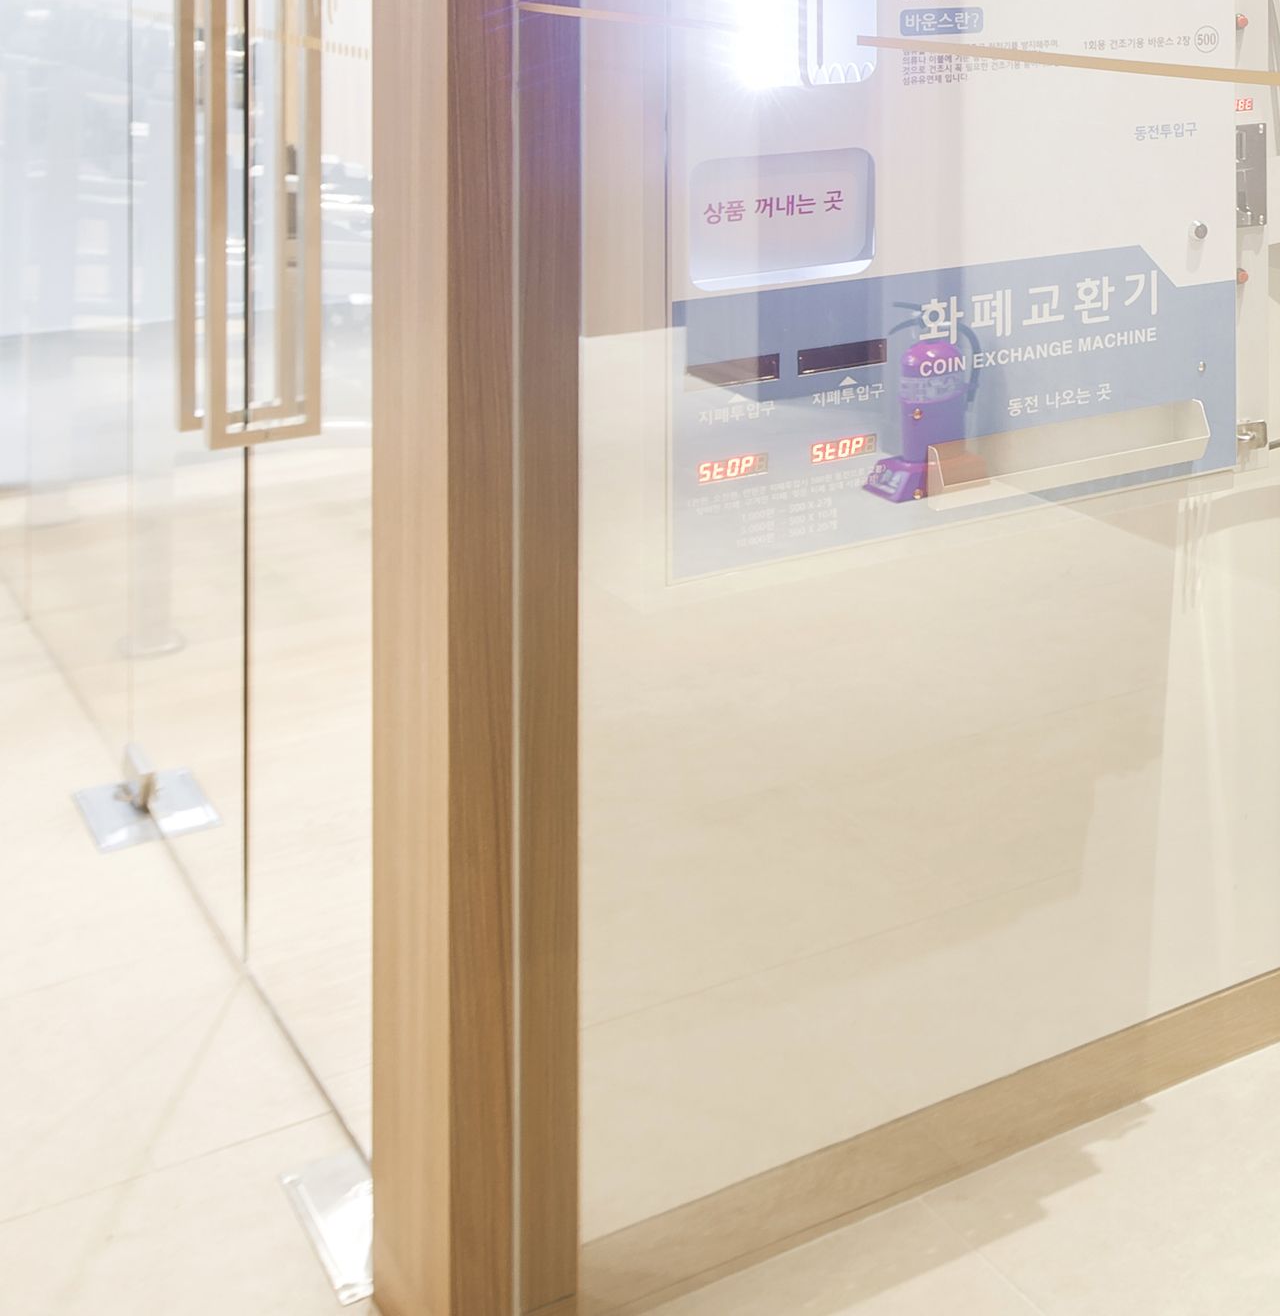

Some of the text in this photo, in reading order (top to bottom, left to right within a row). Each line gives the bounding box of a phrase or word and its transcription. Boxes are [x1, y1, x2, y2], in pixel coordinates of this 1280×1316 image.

[905, 10, 980, 32] 바운스란?
[1147, 36, 1174, 49] 바운스
[1197, 32, 1216, 47] 500
[1134, 122, 1197, 141] 동전투입구
[703, 190, 844, 225] 상품 꺼내는 곳
[919, 269, 1159, 345] 화폐교환기
[919, 327, 1157, 377] COIN EXCHANGE MACHINE
[812, 383, 885, 407] 지폐투입구
[1007, 383, 1112, 417] 동전 나오는 곳
[698, 400, 776, 425] 지폐투입구
